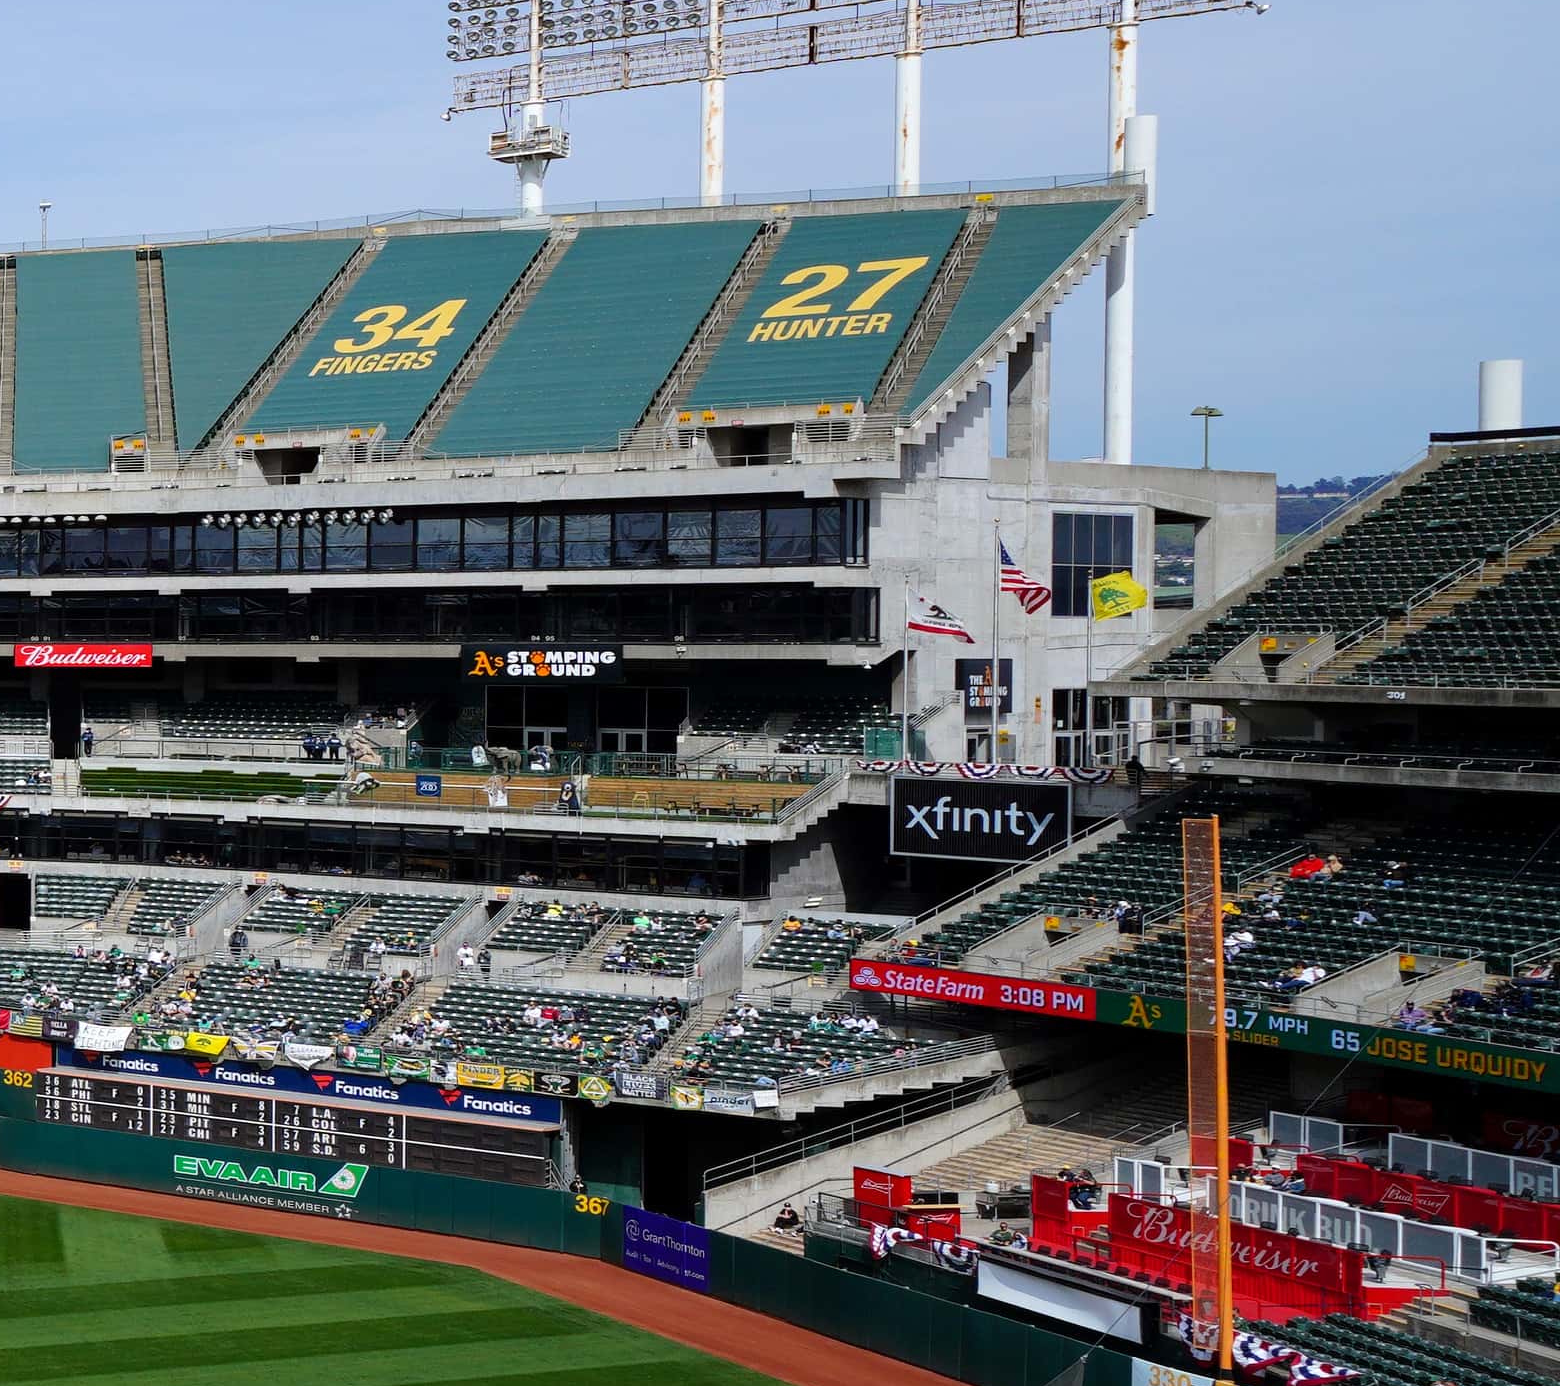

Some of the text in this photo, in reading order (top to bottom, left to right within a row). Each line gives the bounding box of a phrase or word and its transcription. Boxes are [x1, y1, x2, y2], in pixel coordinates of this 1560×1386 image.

[761, 256, 930, 318] 27
[333, 299, 468, 355] 34
[746, 312, 893, 343] HUNTER
[307, 349, 438, 377] FINGERS
[21, 644, 147, 667] Budweiser
[905, 795, 1055, 847] xfinity
[1000, 984, 1045, 1007] 3:08
[1052, 989, 1085, 1012] PM
[1269, 1015, 1309, 1035] MPH
[1331, 1029, 1361, 1052] 65
[1366, 1036, 1428, 1064] JOSE
[1436, 1047, 1547, 1083] URQUIDY
[1233, 1031, 1279, 1046] SLIDER
[102, 1055, 158, 1073] Fanatics
[3, 1070, 32, 1088] 362
[215, 1067, 275, 1086] Fanatics
[622, 1073, 656, 1083] BLACK
[622, 1081, 656, 1091] LIVES
[335, 1081, 399, 1100] Fanatics
[622, 1088, 657, 1099] MATTER
[463, 1096, 531, 1116] Fanatics
[173, 1155, 316, 1192] EVA AIR
[175, 1185, 330, 1213] A STAR ALLIANCE MEMBER
[575, 1195, 611, 1216] 367
[1388, 1186, 1442, 1211] Budweiser
[1319, 1212, 1372, 1248] BUD
